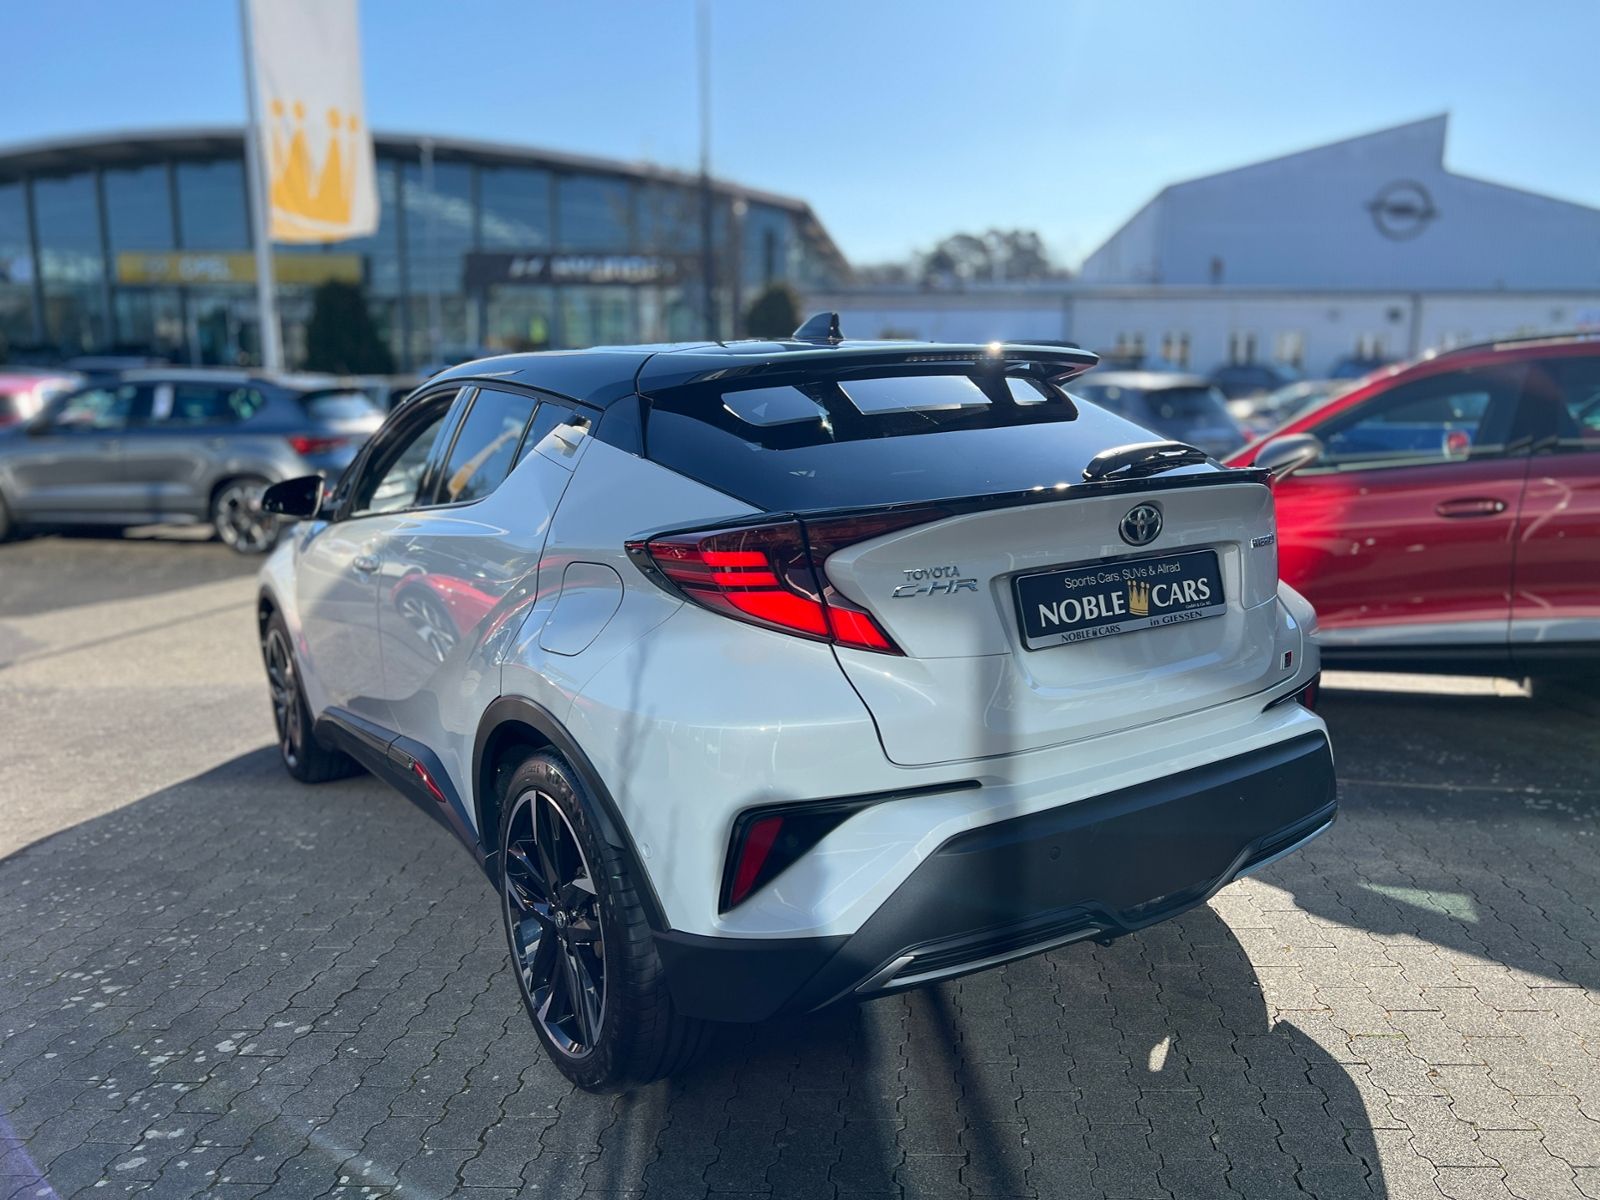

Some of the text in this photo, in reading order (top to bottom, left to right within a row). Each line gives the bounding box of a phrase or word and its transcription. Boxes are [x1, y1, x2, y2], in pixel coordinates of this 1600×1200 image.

[903, 565, 960, 581] TOYOTA
[1064, 576, 1096, 591] Sports
[1122, 567, 1147, 580] SUVs
[1148, 565, 1156, 576] &
[1157, 562, 1181, 574] Allrad
[891, 578, 979, 598] C-HR
[1038, 577, 1211, 627] NOBLE CARS
[1149, 611, 1203, 627] in GIESSEN
[1061, 624, 1121, 643] NOBLE CARS
